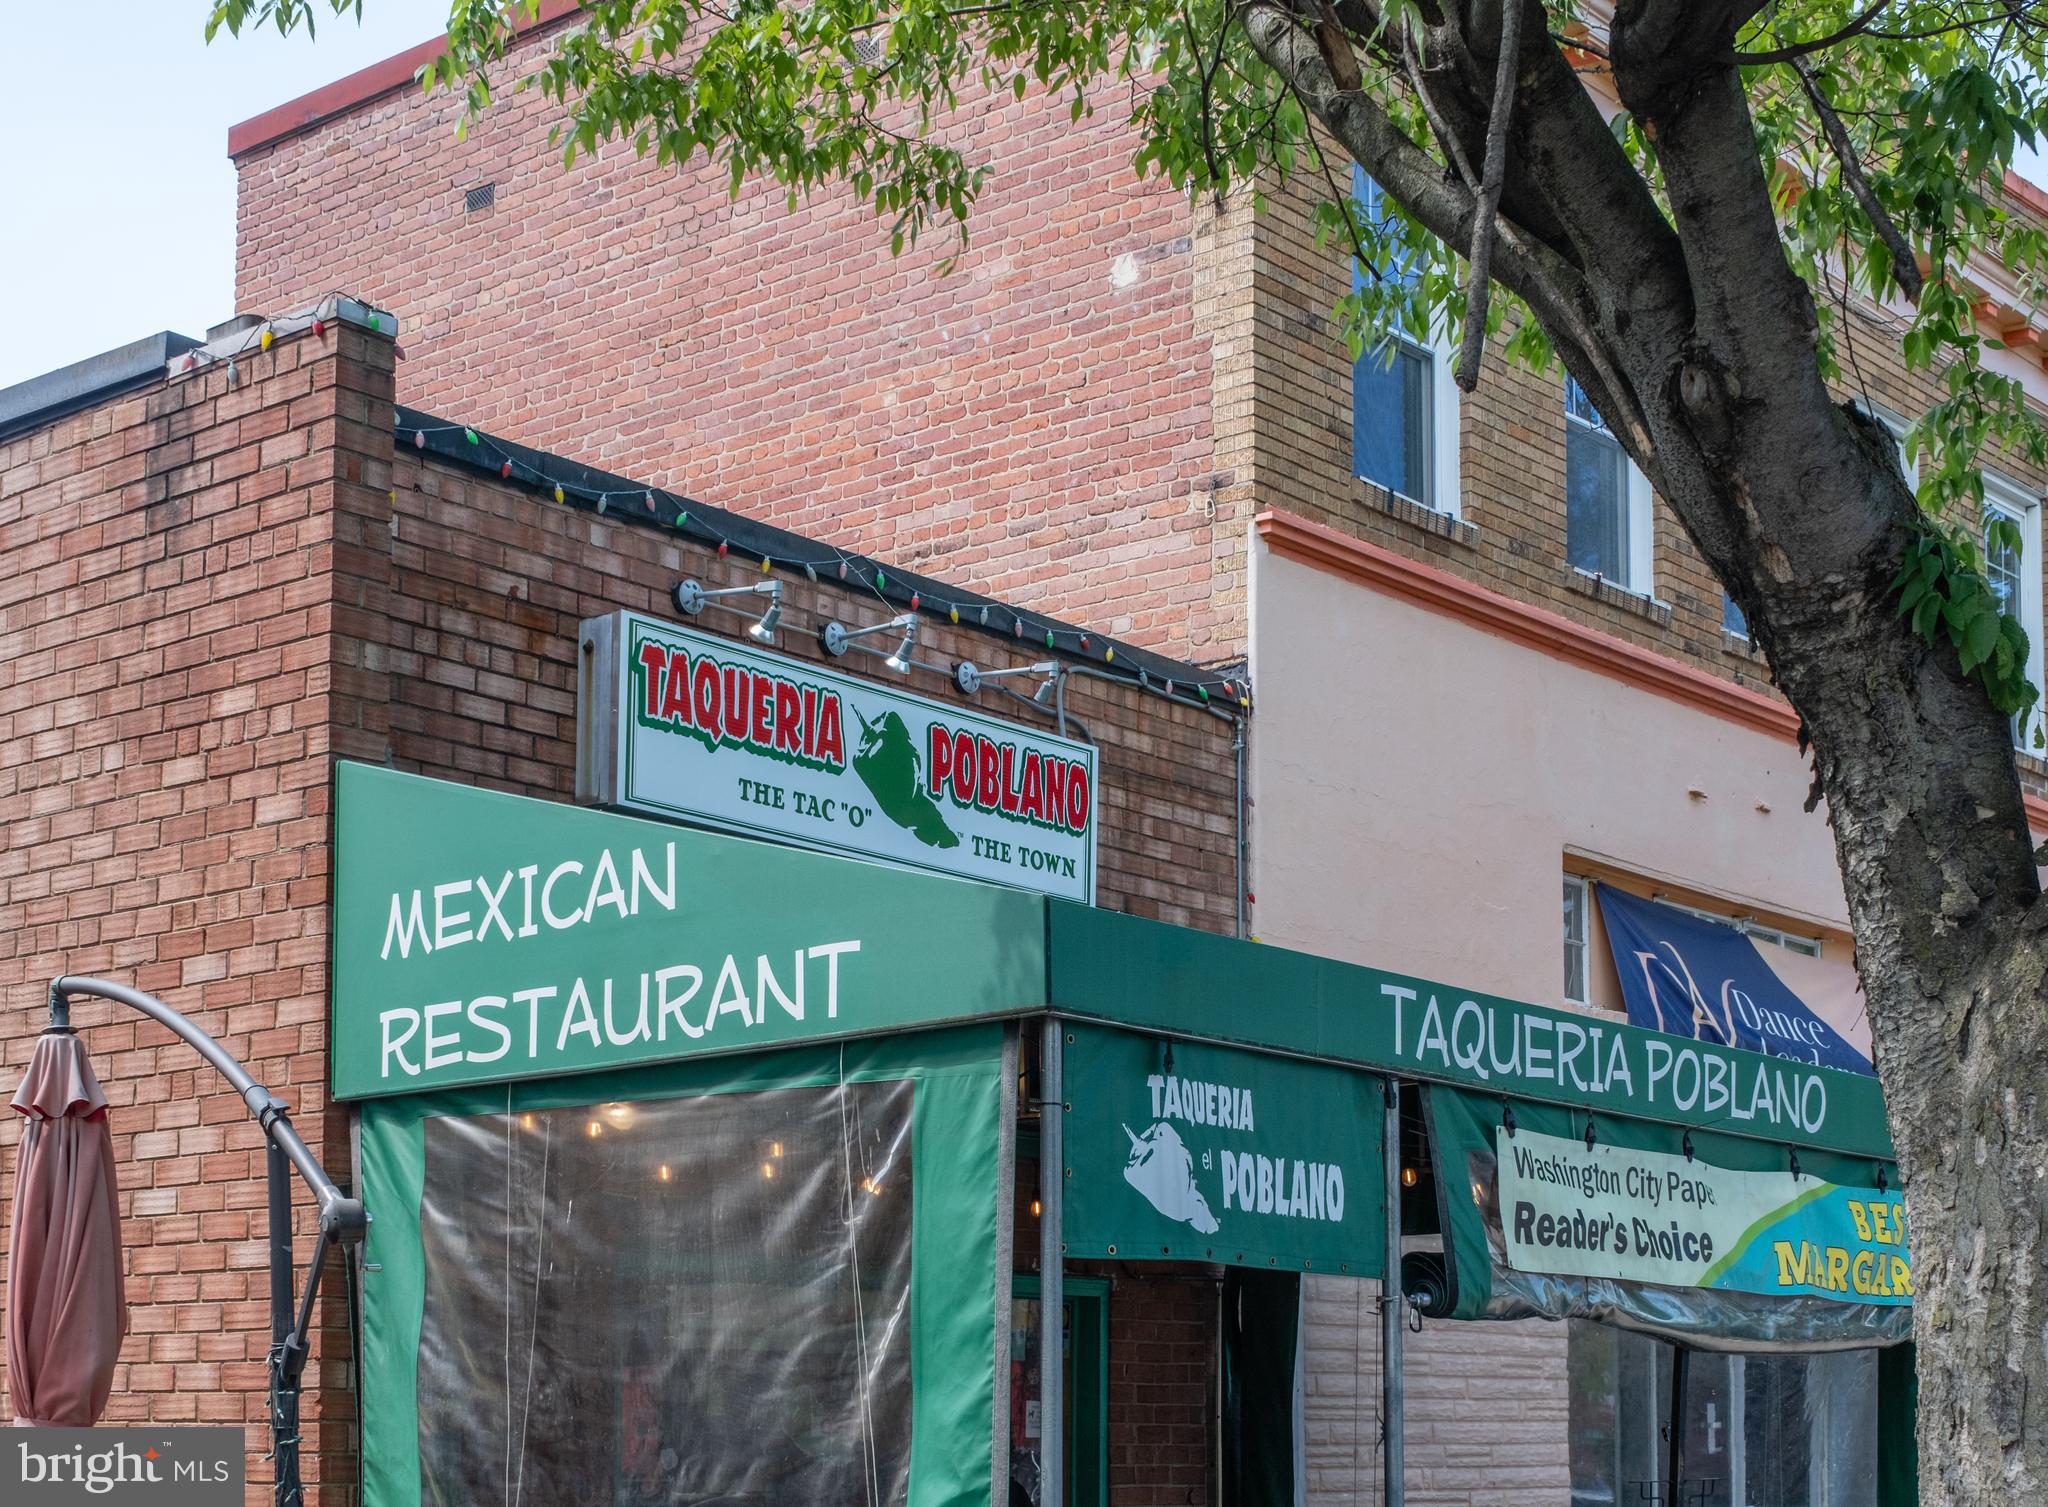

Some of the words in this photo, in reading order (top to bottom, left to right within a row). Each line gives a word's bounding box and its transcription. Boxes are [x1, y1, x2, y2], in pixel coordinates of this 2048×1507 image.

[640, 644, 844, 765] TAQUERIA
[931, 725, 1089, 829] POBLANO
[738, 777, 785, 810] THE
[793, 791, 836, 822] TAC
[841, 801, 872, 828] "O"
[971, 835, 1012, 863] THE
[1018, 847, 1076, 878] TOWN
[381, 841, 676, 960] MEXICAN
[379, 939, 861, 1079] RESTAURANT
[1730, 988, 1831, 1049] Dance
[1380, 983, 1634, 1097] TAQUERIA
[1646, 1040, 1827, 1134] POBLANO
[1147, 1074, 1254, 1132] TAQUERIA
[1202, 1148, 1213, 1180] el
[1220, 1150, 1345, 1222] POBLANO
[1513, 1146, 1621, 1199] Washington
[1626, 1166, 1663, 1207] City
[1514, 1201, 1628, 1255] Reader's
[1632, 1216, 1713, 1264] Choice
